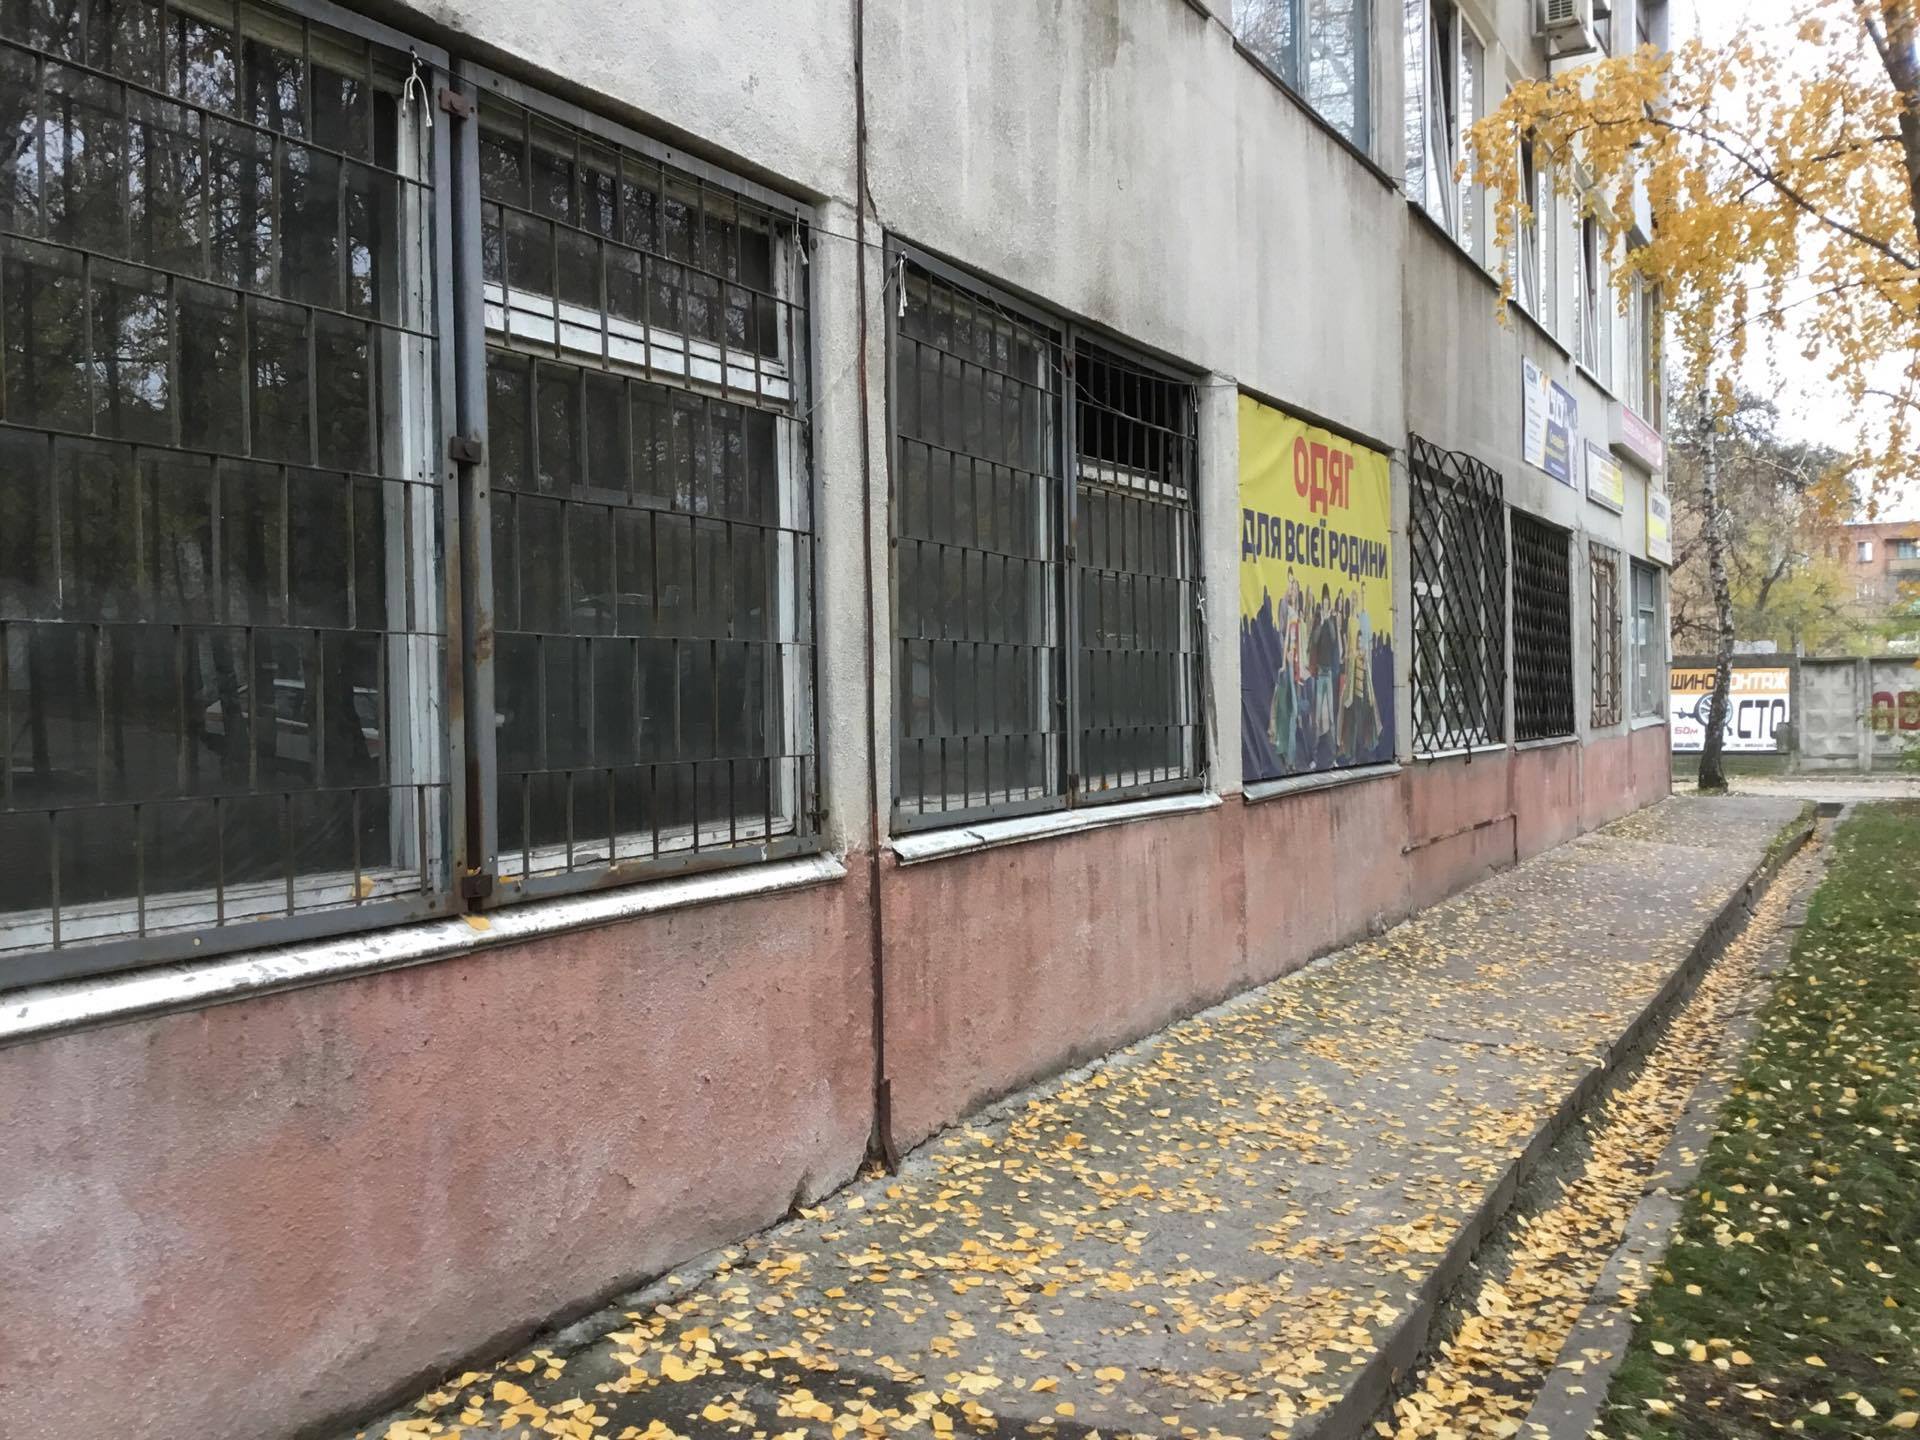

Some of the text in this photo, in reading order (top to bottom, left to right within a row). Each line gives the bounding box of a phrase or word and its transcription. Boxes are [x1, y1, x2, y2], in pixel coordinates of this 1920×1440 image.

[1293, 436, 1354, 516] ОДЯГ
[1242, 508, 1388, 582] ДЛЯ ВСІЄЇ РОДИНИ
[1670, 672, 1789, 690] ШИНООНТАЖ
[1737, 699, 1786, 739] СТО
